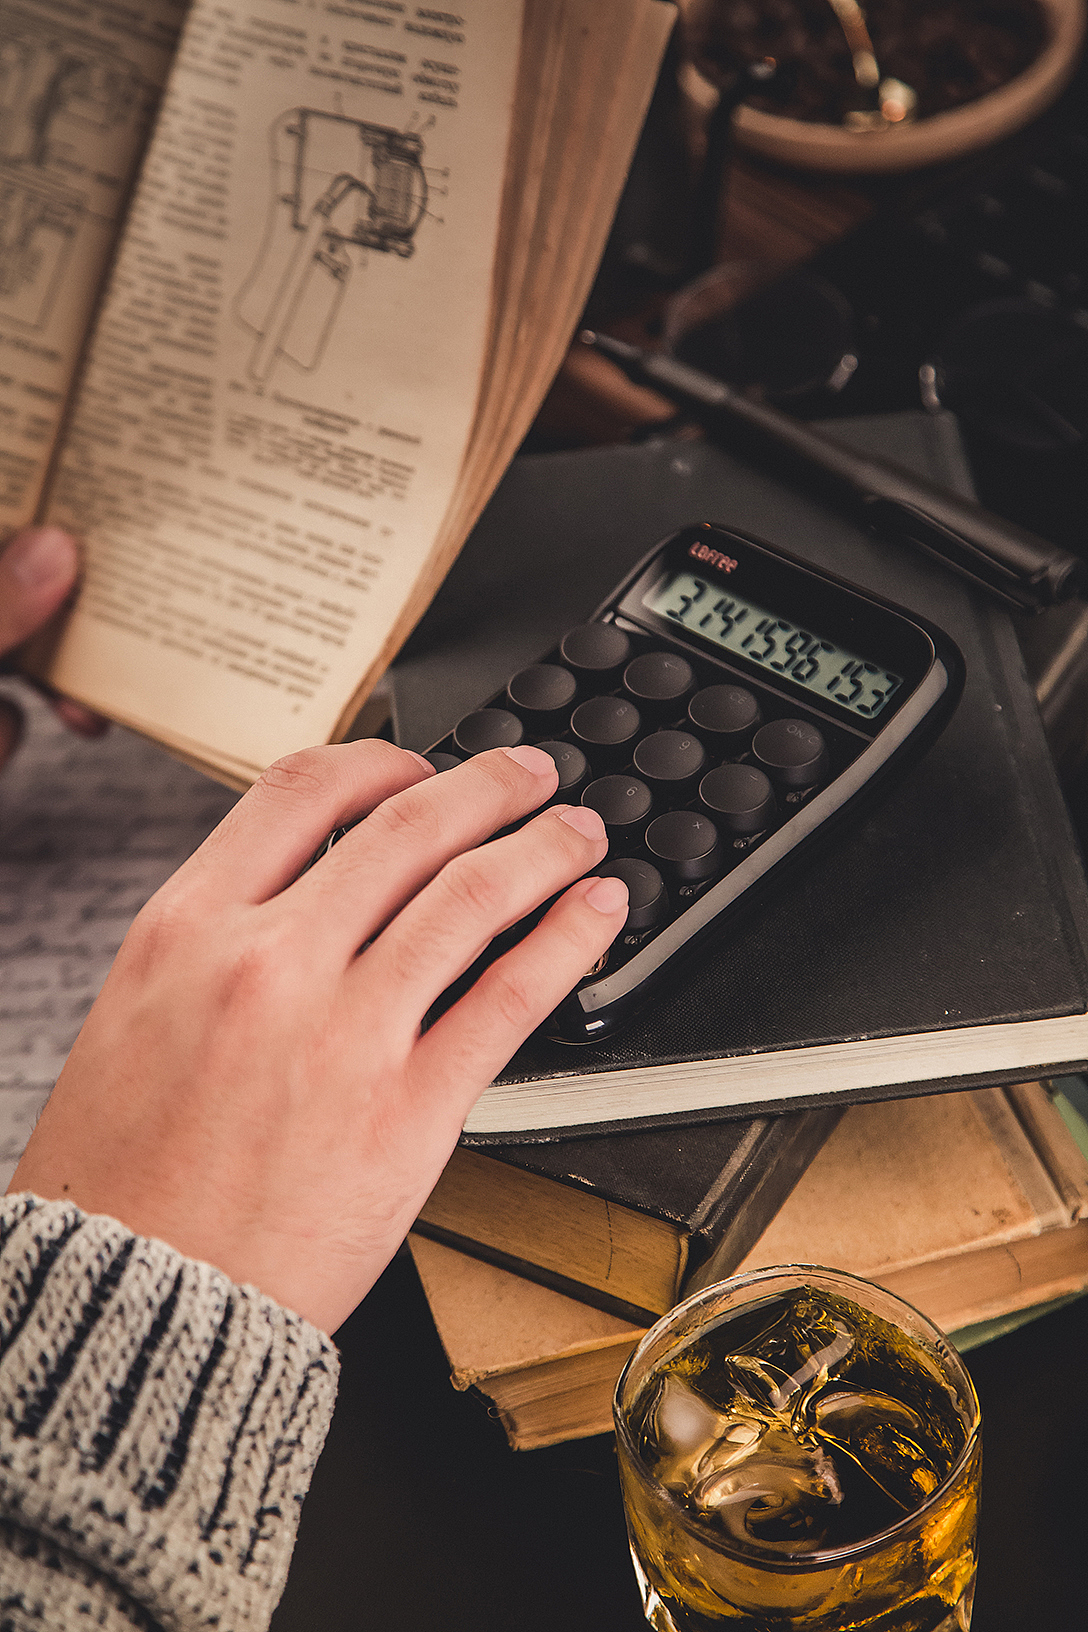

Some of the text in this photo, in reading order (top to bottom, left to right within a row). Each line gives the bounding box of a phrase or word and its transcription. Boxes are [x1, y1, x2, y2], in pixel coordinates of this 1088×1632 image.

[616, 706, 628, 717] 8
[678, 739, 692, 751] 9
[561, 750, 574, 762] 5
[626, 785, 638, 797] 6
